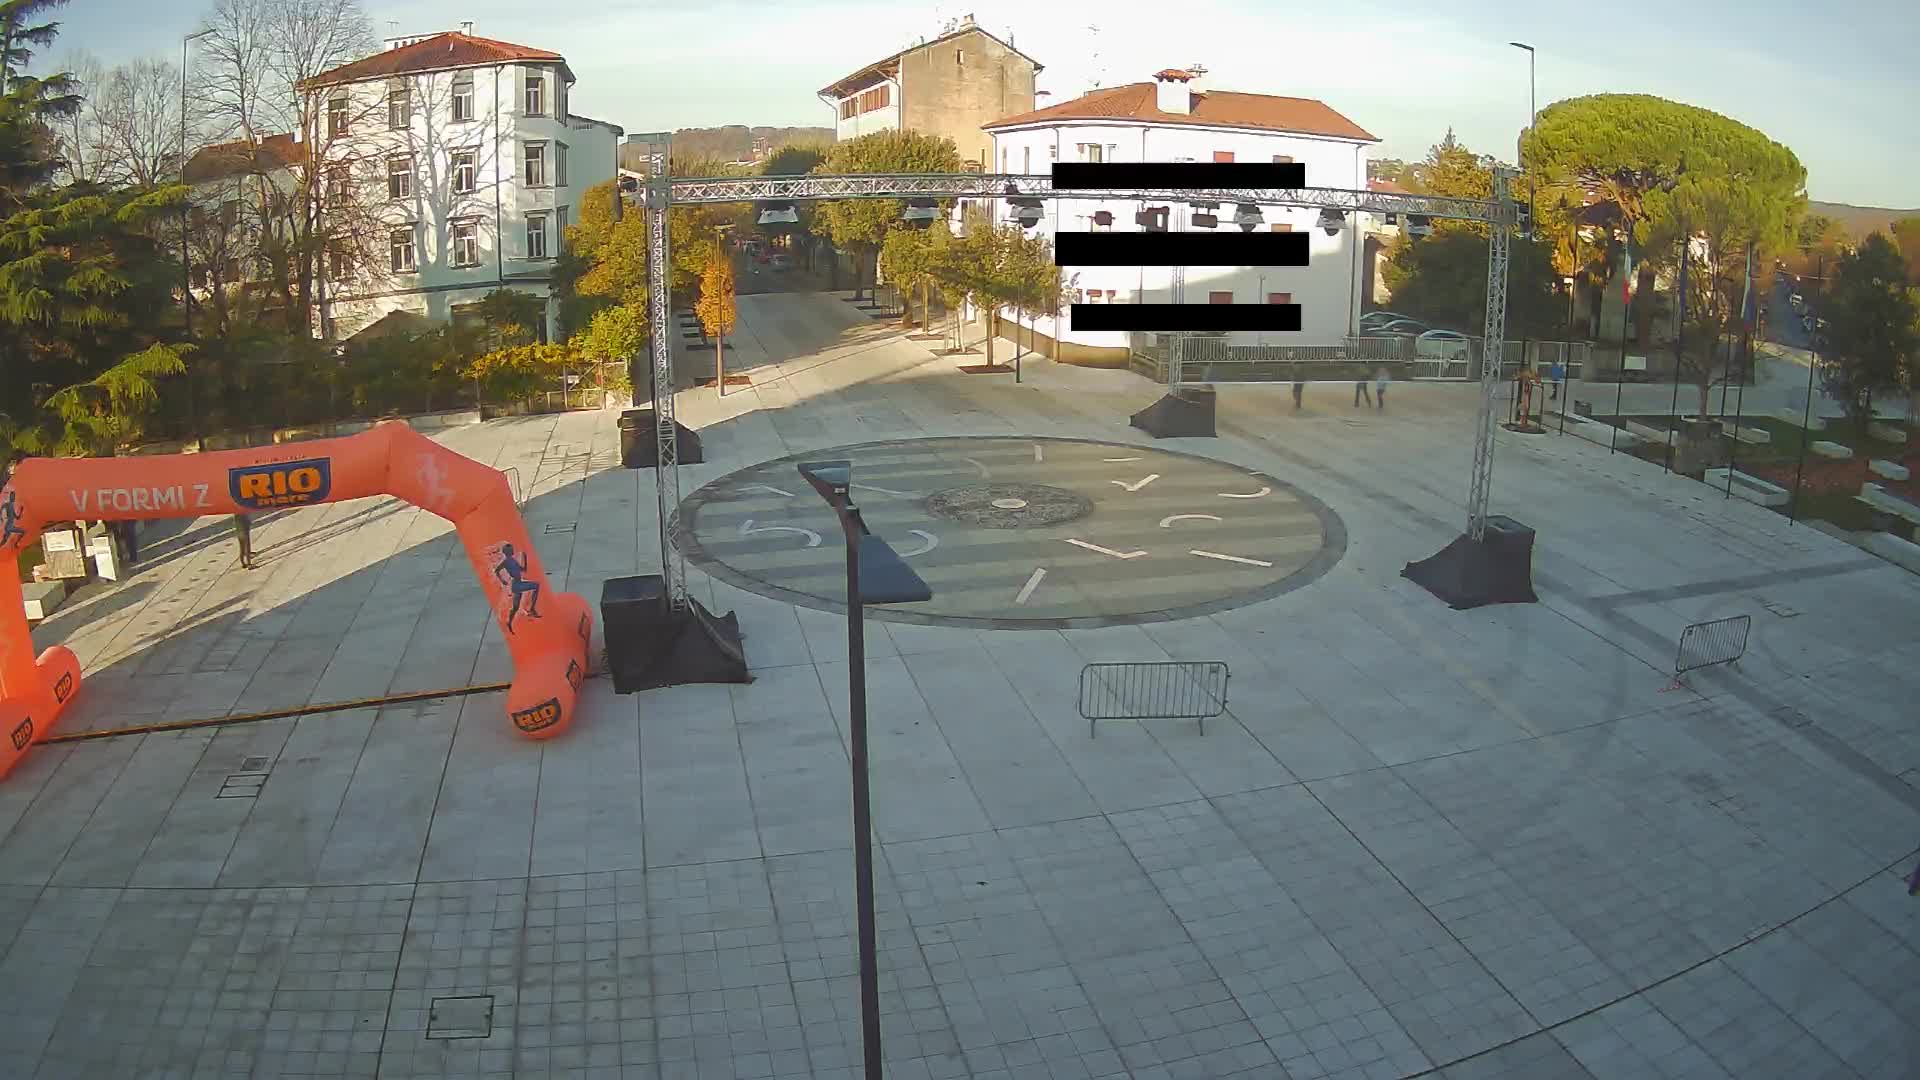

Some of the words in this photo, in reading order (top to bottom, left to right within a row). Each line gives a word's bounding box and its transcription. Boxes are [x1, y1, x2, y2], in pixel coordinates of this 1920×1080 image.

[240, 467, 321, 498] RIO
[70, 489, 88, 512] V
[96, 485, 184, 511] FORMI
